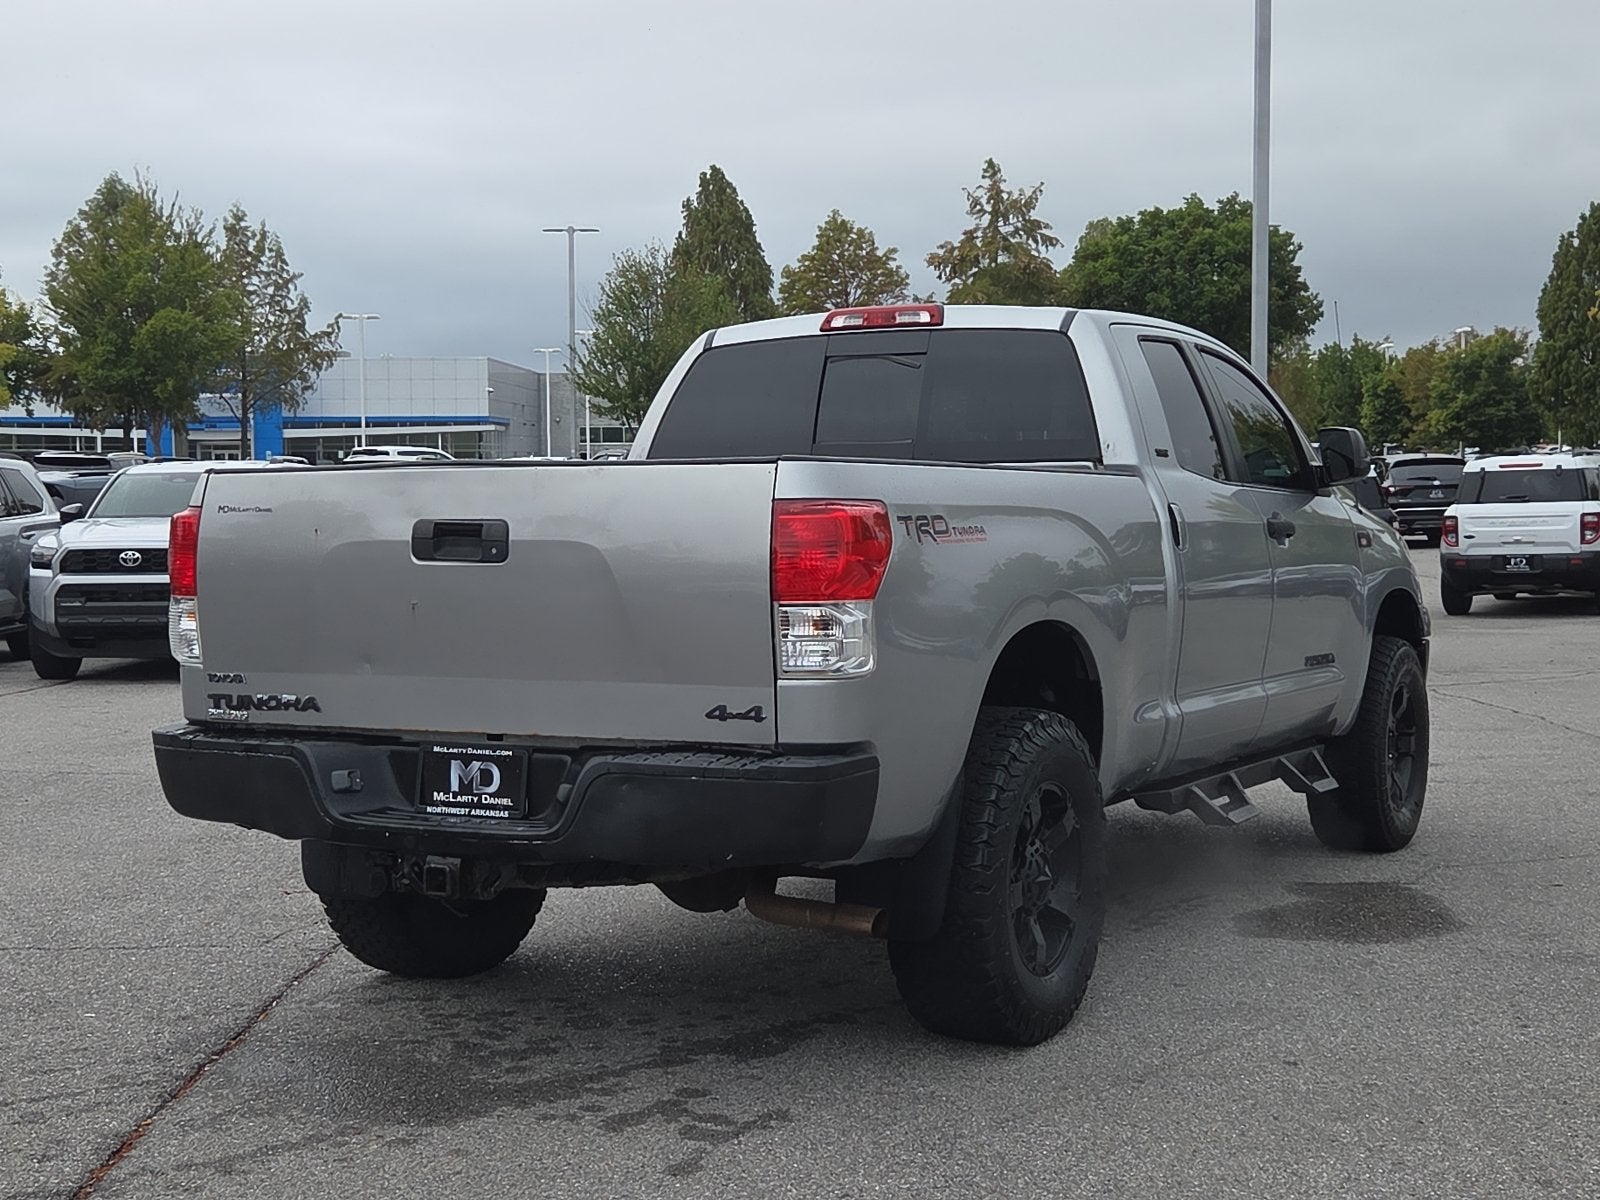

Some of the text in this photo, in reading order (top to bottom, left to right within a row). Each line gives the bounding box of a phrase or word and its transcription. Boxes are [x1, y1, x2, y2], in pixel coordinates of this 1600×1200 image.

[897, 515, 986, 544] TRD TUNDRA
[207, 694, 322, 713] TUNDRA
[450, 760, 501, 793] MD
[426, 805, 509, 818] NORTHWEST ARKANSAS
